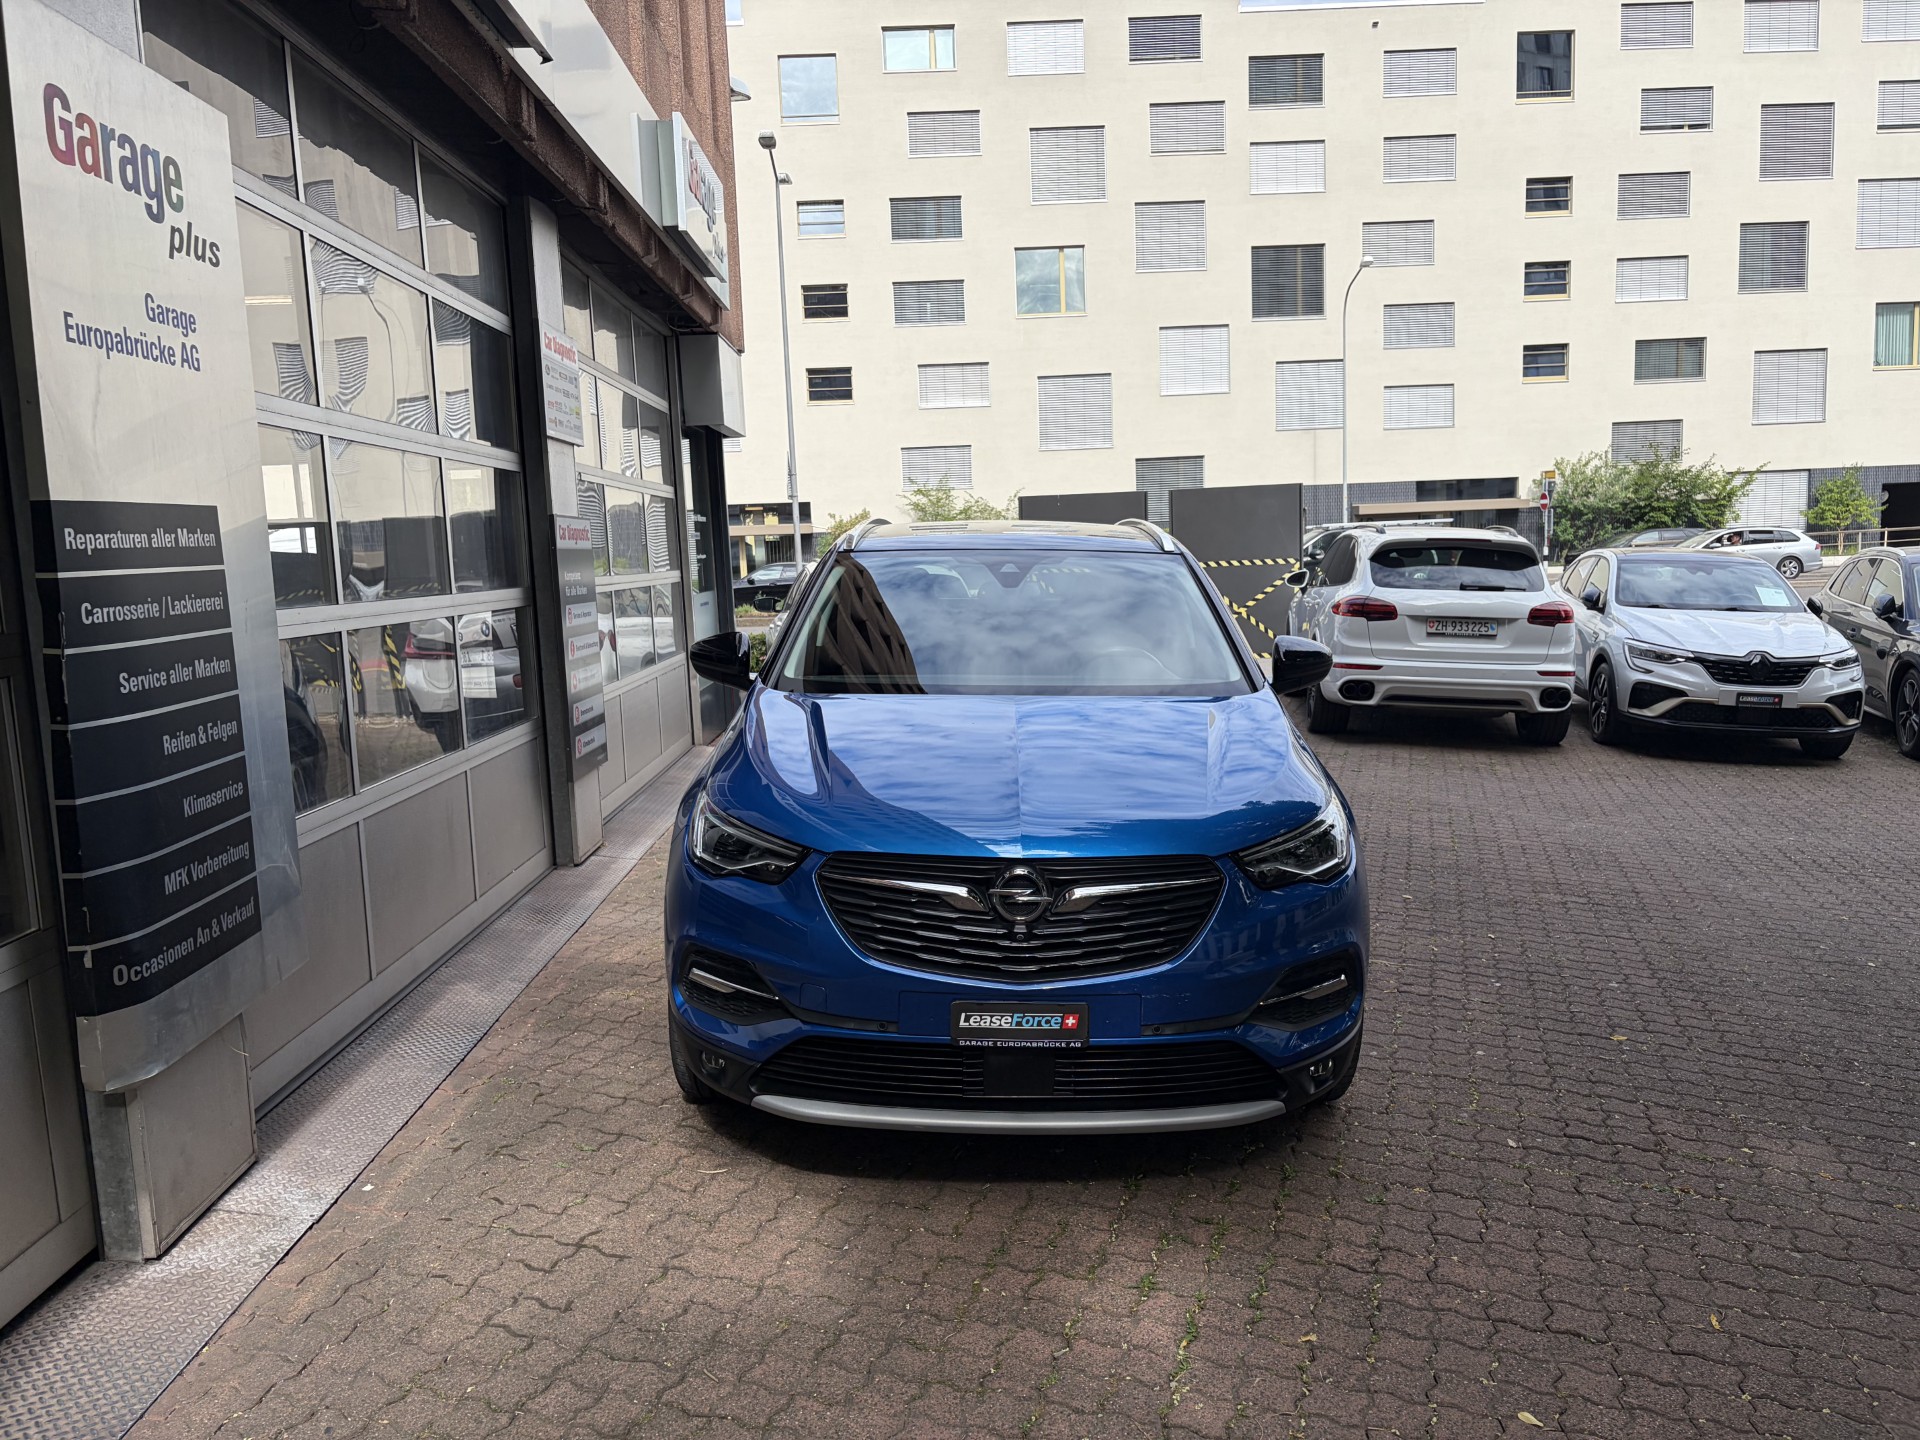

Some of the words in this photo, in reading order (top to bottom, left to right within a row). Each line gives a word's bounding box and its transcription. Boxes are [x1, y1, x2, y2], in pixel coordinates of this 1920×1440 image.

[43, 82, 184, 224] Garage
[168, 221, 221, 268] plus
[144, 292, 197, 338] Garage
[63, 310, 177, 367] Europabrücke
[180, 341, 201, 372] AG
[63, 527, 149, 556] Reparaturen
[151, 528, 176, 548] aller
[177, 528, 216, 548] Marken
[81, 598, 160, 625] Carrosserie
[167, 592, 224, 616] Lackiererei
[119, 668, 167, 694] Service
[169, 662, 194, 685] aller
[194, 656, 231, 680] Marken
[163, 731, 197, 756] Reifen
[198, 725, 207, 745] &
[207, 719, 238, 742] Felgen
[183, 780, 244, 818] Klimaservice
[164, 868, 190, 896] MFK
[190, 841, 250, 880] Vorbereitung
[112, 935, 195, 987] Occasionen
[196, 926, 211, 947] An
[211, 918, 221, 938] &
[220, 896, 256, 931] Verkauf
[959, 1012, 1062, 1027] LeaseForce
[997, 1040, 1067, 1048] EUROPABRÜCKE
